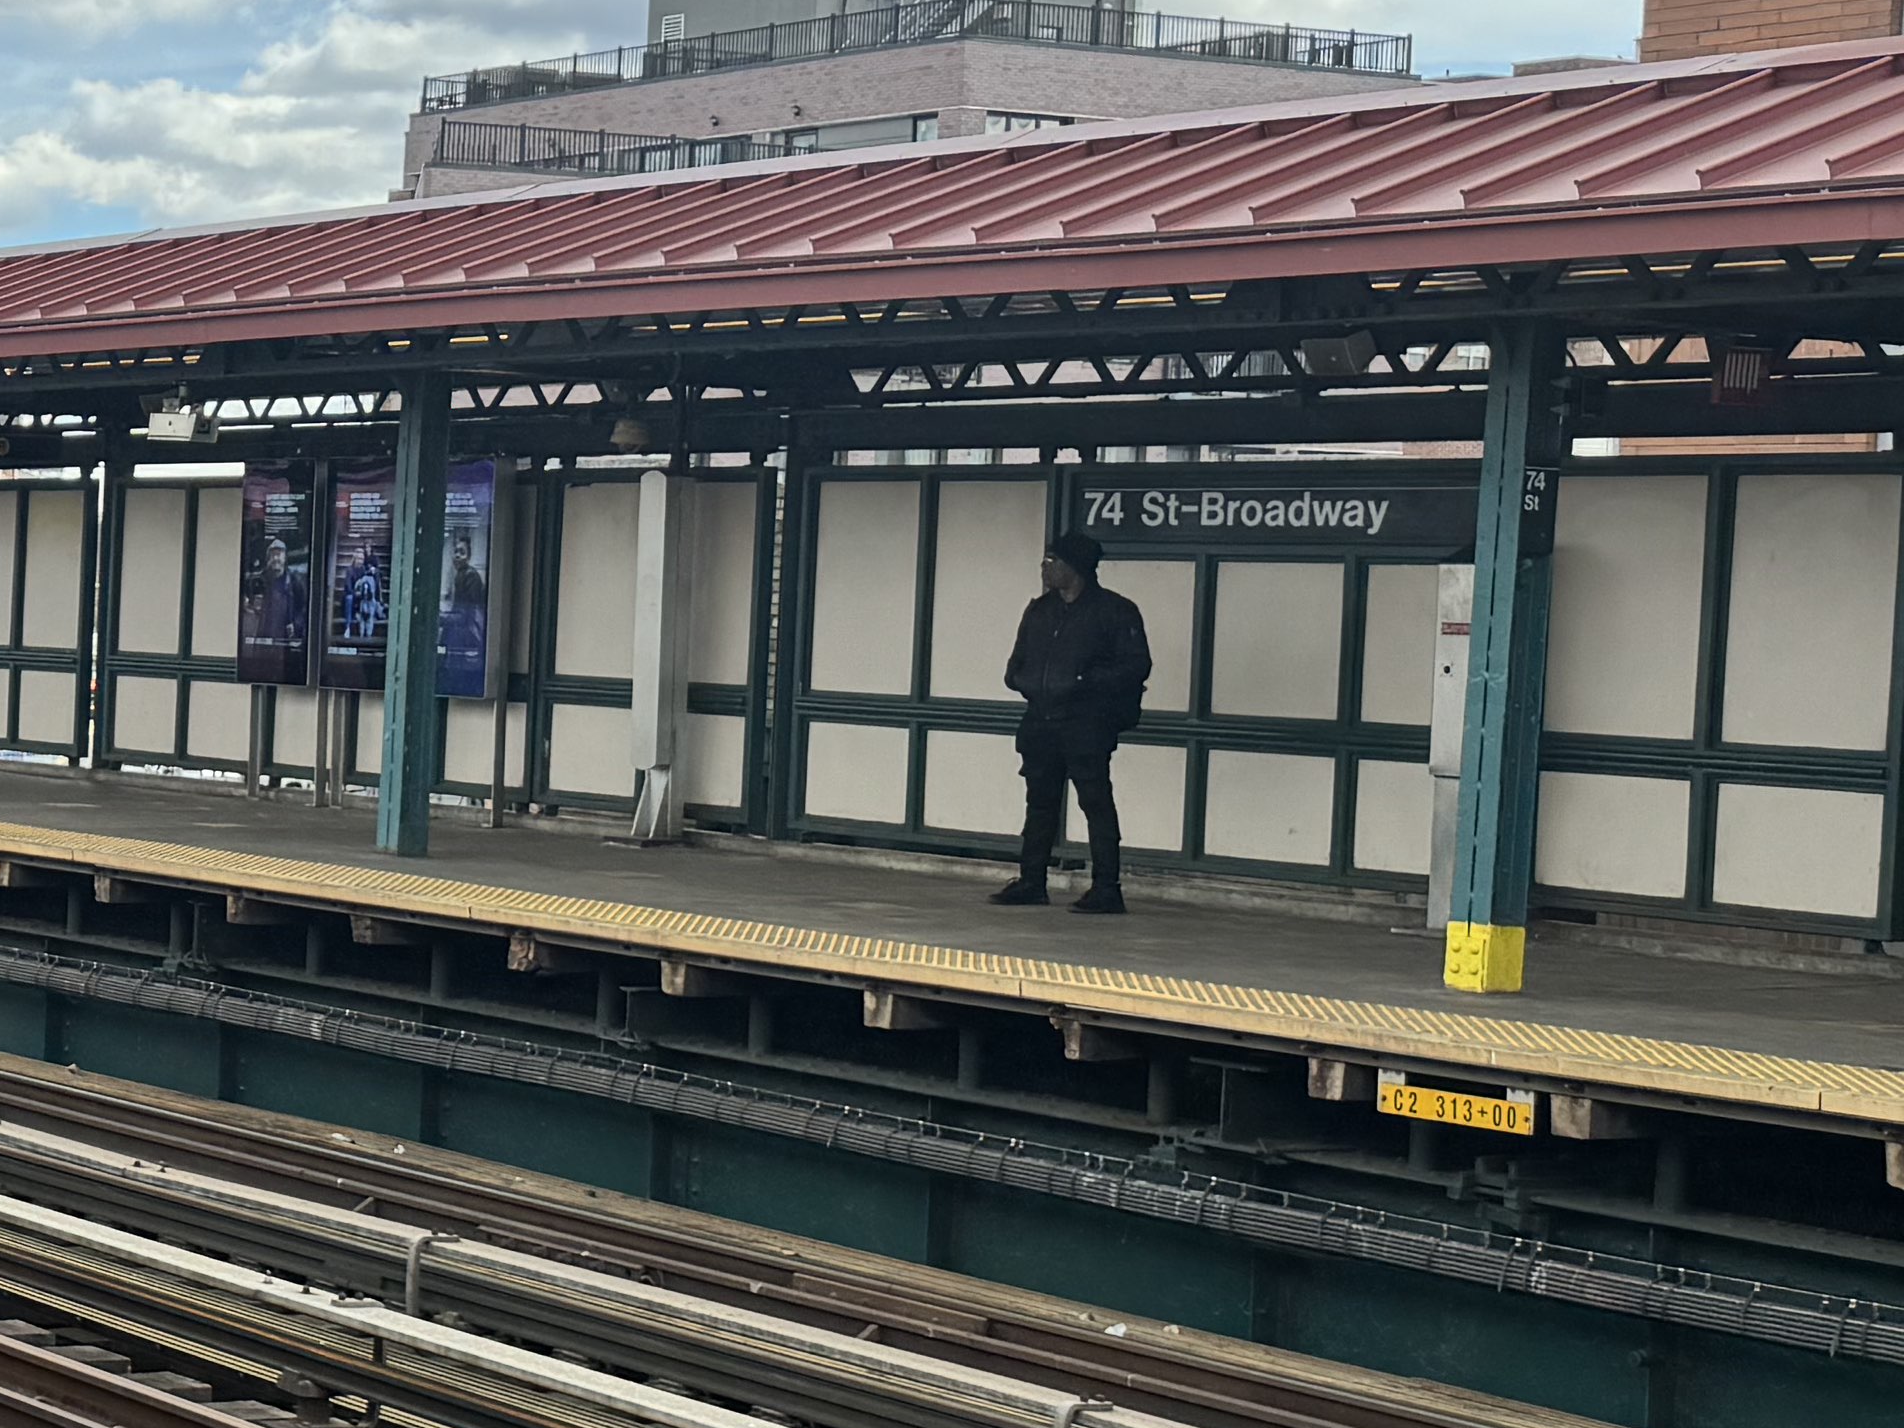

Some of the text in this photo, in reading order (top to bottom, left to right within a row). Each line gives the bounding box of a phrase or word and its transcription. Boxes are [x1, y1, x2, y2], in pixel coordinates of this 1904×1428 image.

[1526, 471, 1546, 491] 74
[1083, 490, 1390, 535] 74 St-Broadway
[1523, 494, 1539, 511] St
[1394, 1088, 1517, 1129] C2 313+00
